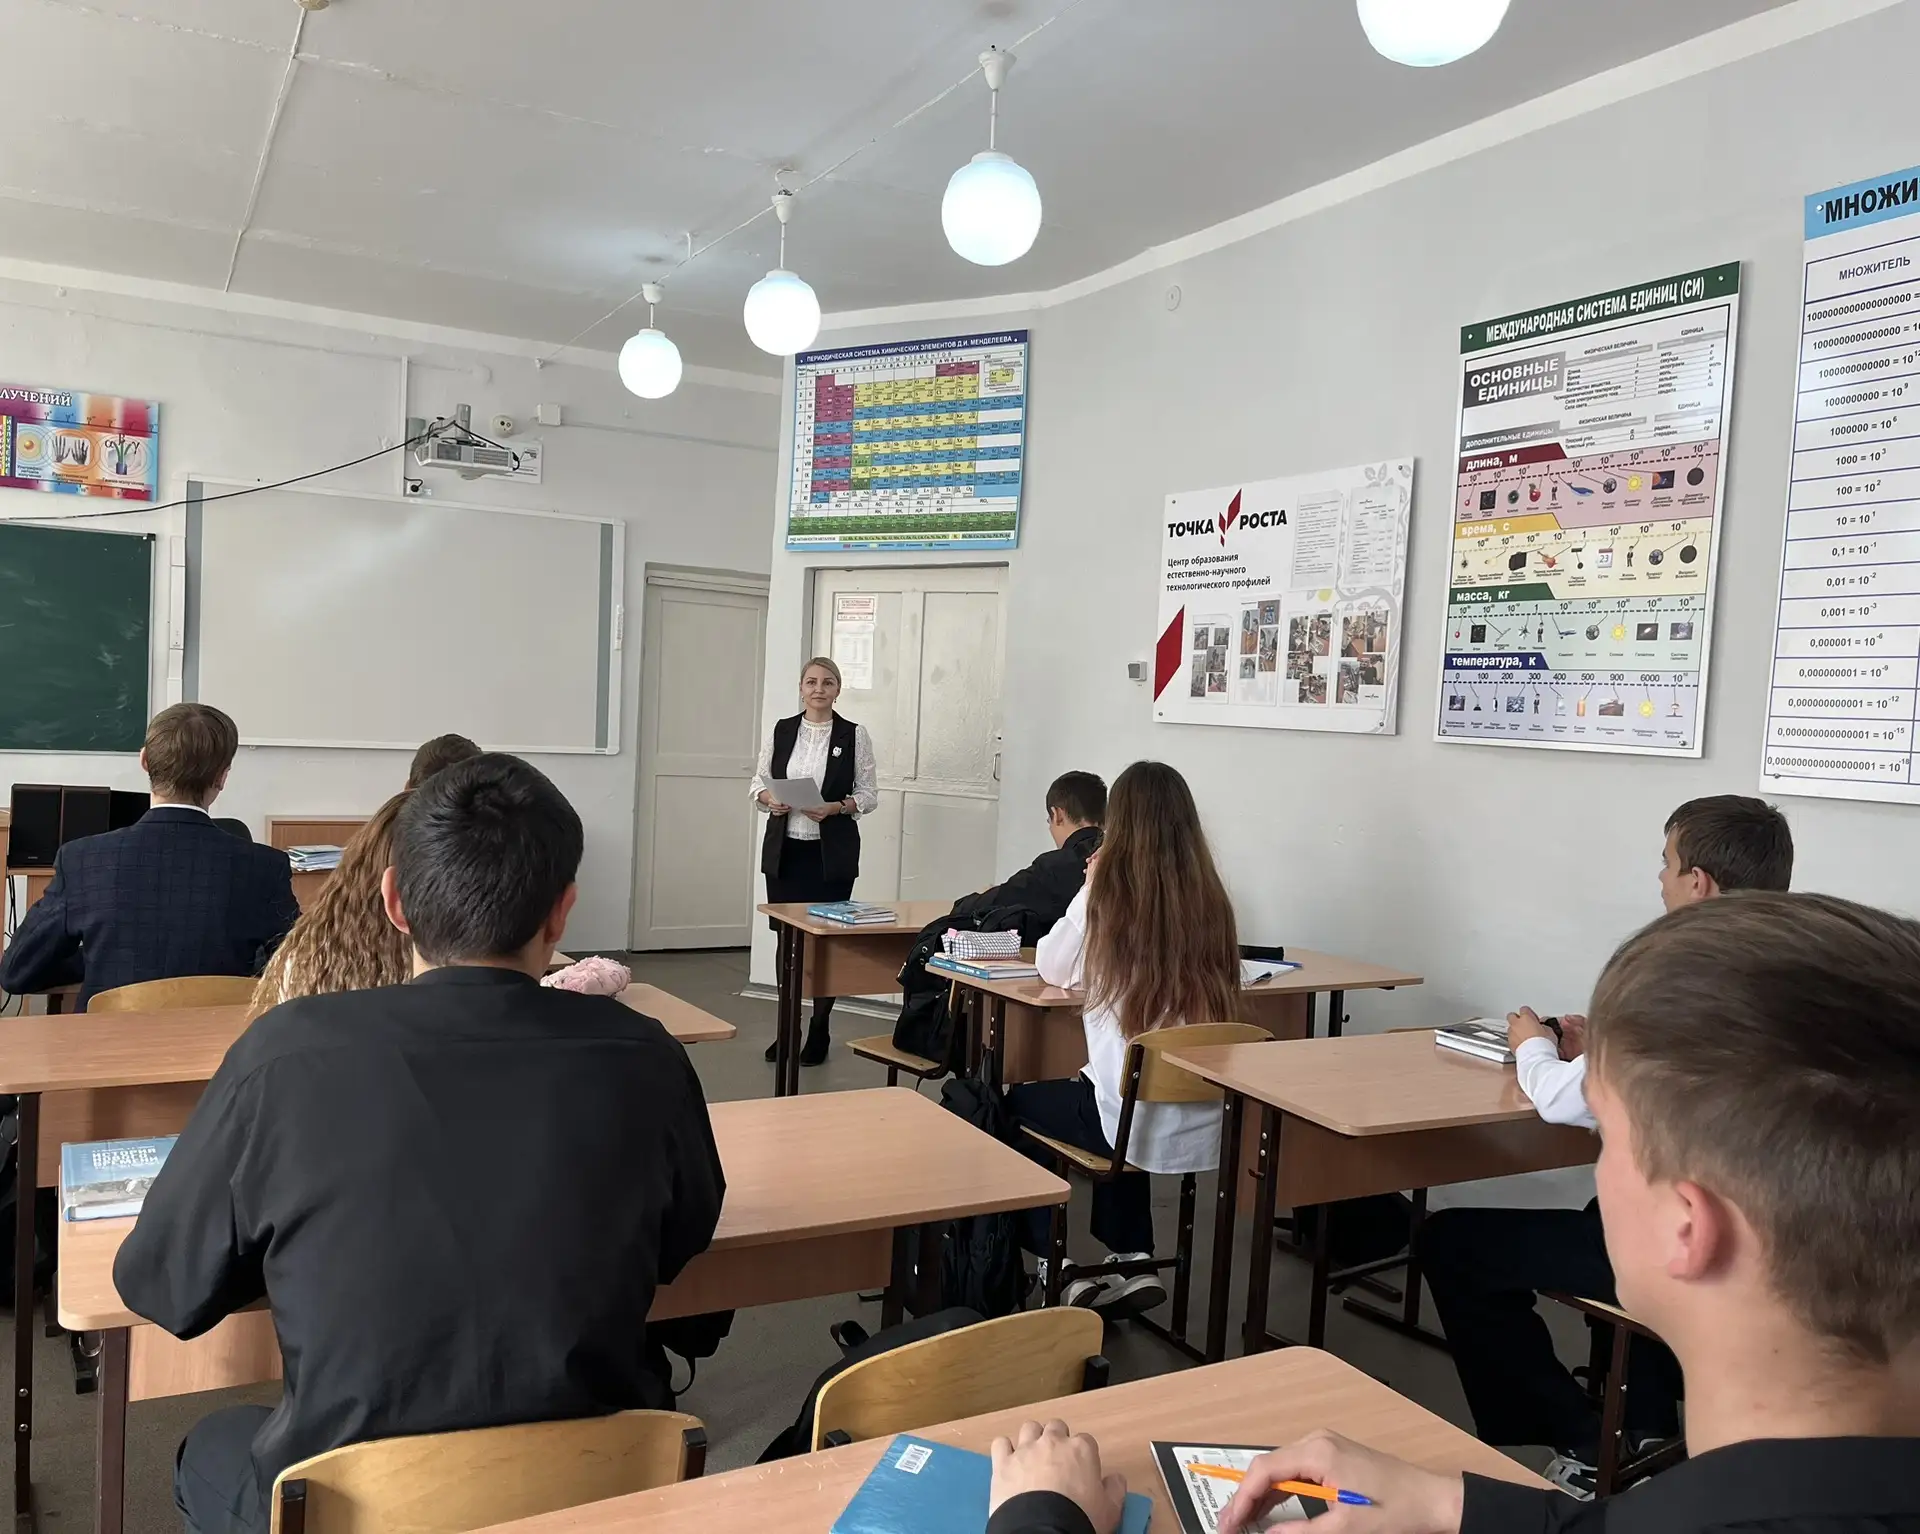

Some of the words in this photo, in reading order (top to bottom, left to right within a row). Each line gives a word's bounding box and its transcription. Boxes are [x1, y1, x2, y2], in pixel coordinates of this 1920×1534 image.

[1825, 177, 1920, 224] МНОЖИ
[1838, 256, 1911, 280] МНОЖИТЕЛЬ
[1486, 307, 1574, 342] МЕЖДУНАРОДНАЯ
[1576, 294, 1627, 321] СИСТЕМА
[1630, 282, 1677, 312] ЕДИНИЦ
[1680, 276, 1704, 303] (СИ)
[806, 352, 852, 361] ПЕРИОДИЧЕСКАЯ
[854, 349, 880, 357] СИСТЕМА
[881, 344, 919, 354] ХИМИЧЕСКИХ
[920, 341, 956, 350] ЭЛЕМЕНТОВ
[971, 336, 1012, 345] МЕНДЕЛЕЕВА
[1470, 358, 1559, 387] ОСНОВНЫЕ
[1478, 374, 1558, 402] ЕДИНИЦЫ
[0, 388, 72, 407] ЛУЧЕНИЙ
[1824, 391, 1880, 407] 1000000000
[1830, 423, 1868, 436] 1000000
[1465, 432, 1521, 449] ДОПОЛНИТЕЛЬНЫЕ
[1466, 456, 1503, 472] длина,
[1836, 455, 1857, 465] 1000
[1836, 486, 1852, 495] 100
[1168, 518, 1214, 538] ТОЧКА
[1240, 510, 1287, 530] РОСТА
[1836, 516, 1847, 525] 10
[1461, 524, 1496, 536] время,
[1832, 547, 1845, 556] 0,1
[1168, 558, 1189, 568] Центр
[1191, 554, 1239, 566] образования
[1167, 566, 1246, 579] естественно-научного
[1166, 581, 1230, 591] технологического
[1232, 576, 1271, 589] профилей
[1827, 578, 1846, 587] 0,01
[1456, 592, 1492, 602] масса,
[1498, 590, 1510, 599] кг
[1821, 608, 1846, 618] 0,001
[1810, 638, 1851, 648] 0,000001
[1452, 656, 1522, 668] температура,
[1640, 674, 1660, 682] 6000
[1799, 668, 1857, 678] 0,000000001
